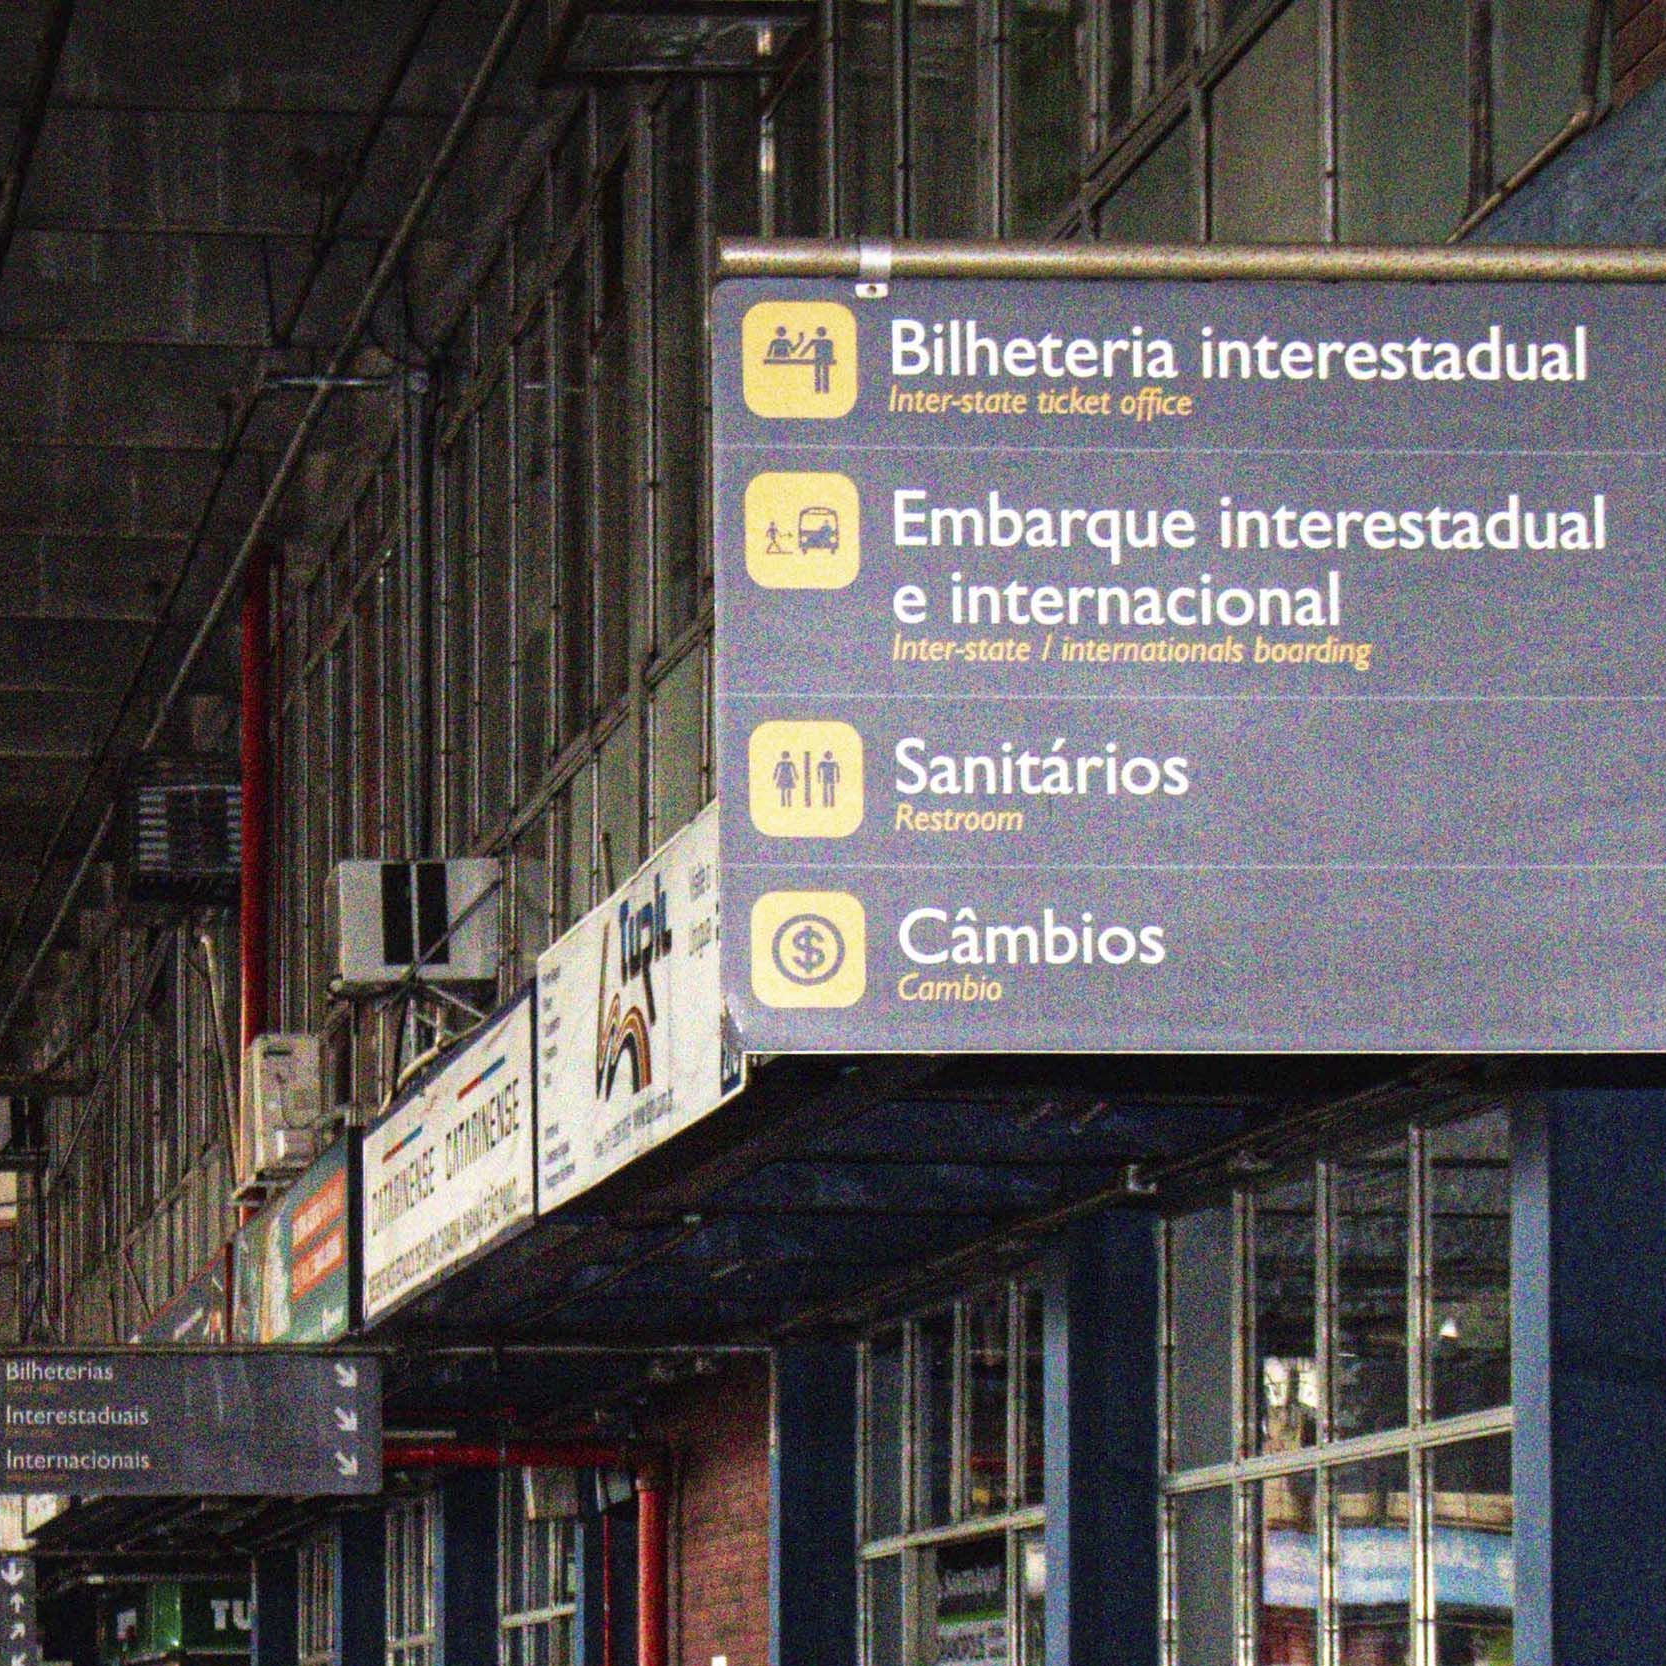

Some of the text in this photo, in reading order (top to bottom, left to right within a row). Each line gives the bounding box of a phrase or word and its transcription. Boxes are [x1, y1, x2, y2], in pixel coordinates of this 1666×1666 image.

[890, 319, 1589, 383] Bilheteria interestadual
[890, 387, 1194, 421] Inter-state ticket office
[893, 491, 1607, 565] Embarque interestadual
[893, 571, 1342, 627] e internacional
[893, 634, 1034, 664] Inter-state
[1060, 635, 1246, 666] internationals
[1254, 636, 1373, 671] boarding
[894, 738, 1191, 797] Sanitários
[895, 804, 1024, 834] Restroom
[897, 905, 1167, 966] Câmbios
[897, 974, 1004, 1004] Cambio
[445, 1077, 520, 1181] CATARINENSE
[6, 1361, 114, 1381] Bilheterias
[6, 1405, 150, 1426] Interestaduais
[6, 1449, 151, 1470] Internacionais
